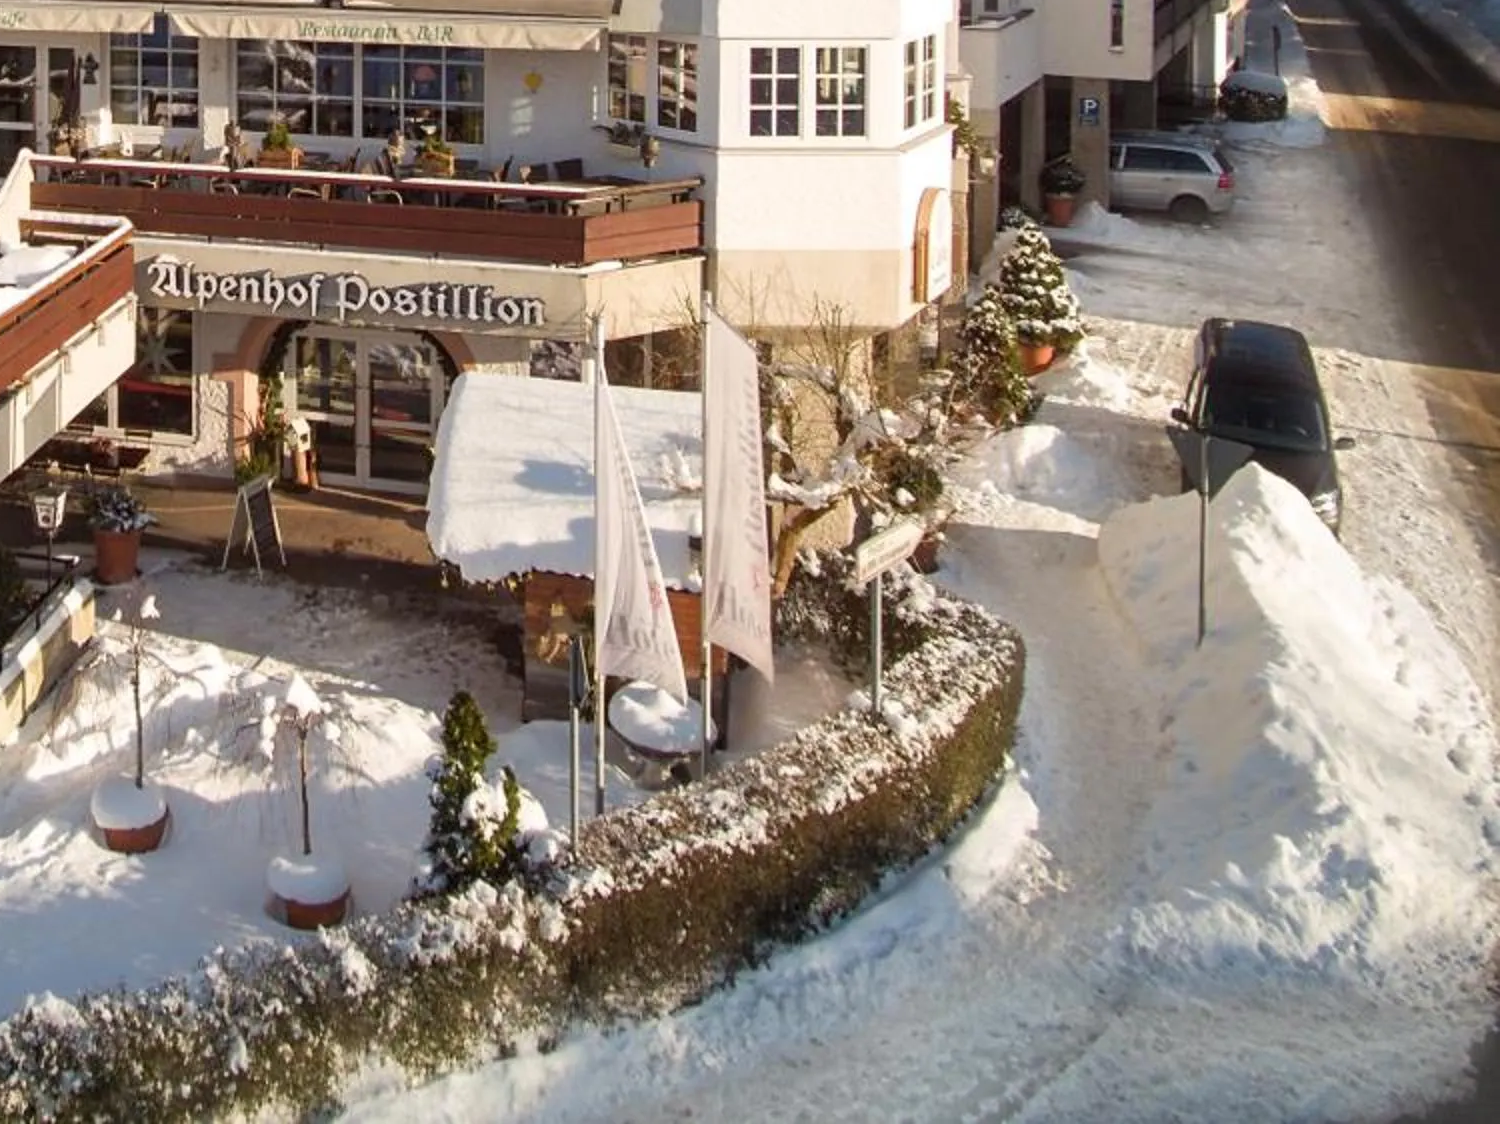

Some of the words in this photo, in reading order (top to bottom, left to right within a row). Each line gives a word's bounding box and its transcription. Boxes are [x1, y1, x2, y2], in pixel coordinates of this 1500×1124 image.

[417, 25, 454, 41] BAR
[1084, 99, 1097, 115] P
[148, 253, 324, 316] Alpenhof
[335, 271, 546, 324] Postillion
